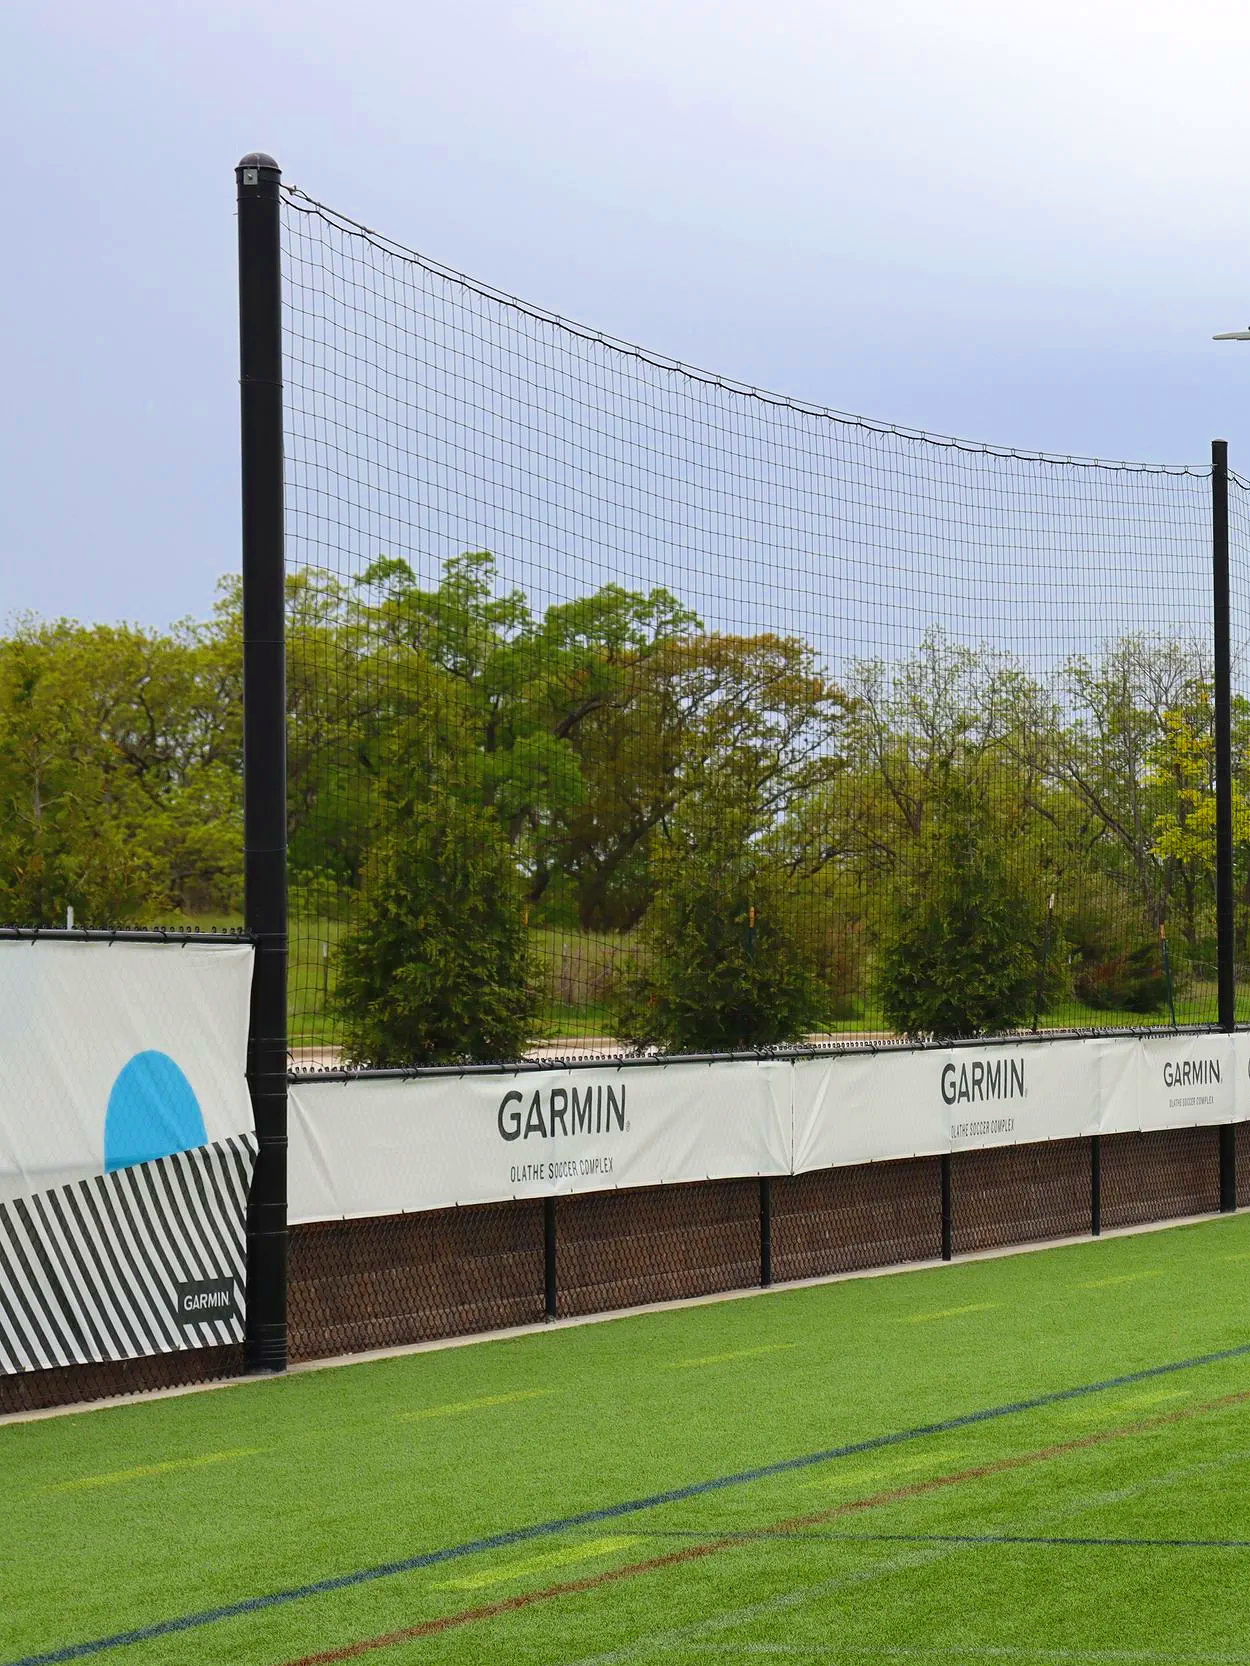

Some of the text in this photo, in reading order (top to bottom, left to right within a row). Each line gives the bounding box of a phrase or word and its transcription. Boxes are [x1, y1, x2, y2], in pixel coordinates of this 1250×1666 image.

[941, 1058, 1024, 1105] GARMIN
[1163, 1059, 1220, 1087] GARMIN
[498, 1084, 626, 1141] GARMIN
[970, 1120, 990, 1137] SOCCER
[991, 1118, 1015, 1134] COMPLEX
[510, 1157, 614, 1183] OLATHE SOCCER COMPLEX
[184, 1291, 229, 1311] GARMIN
